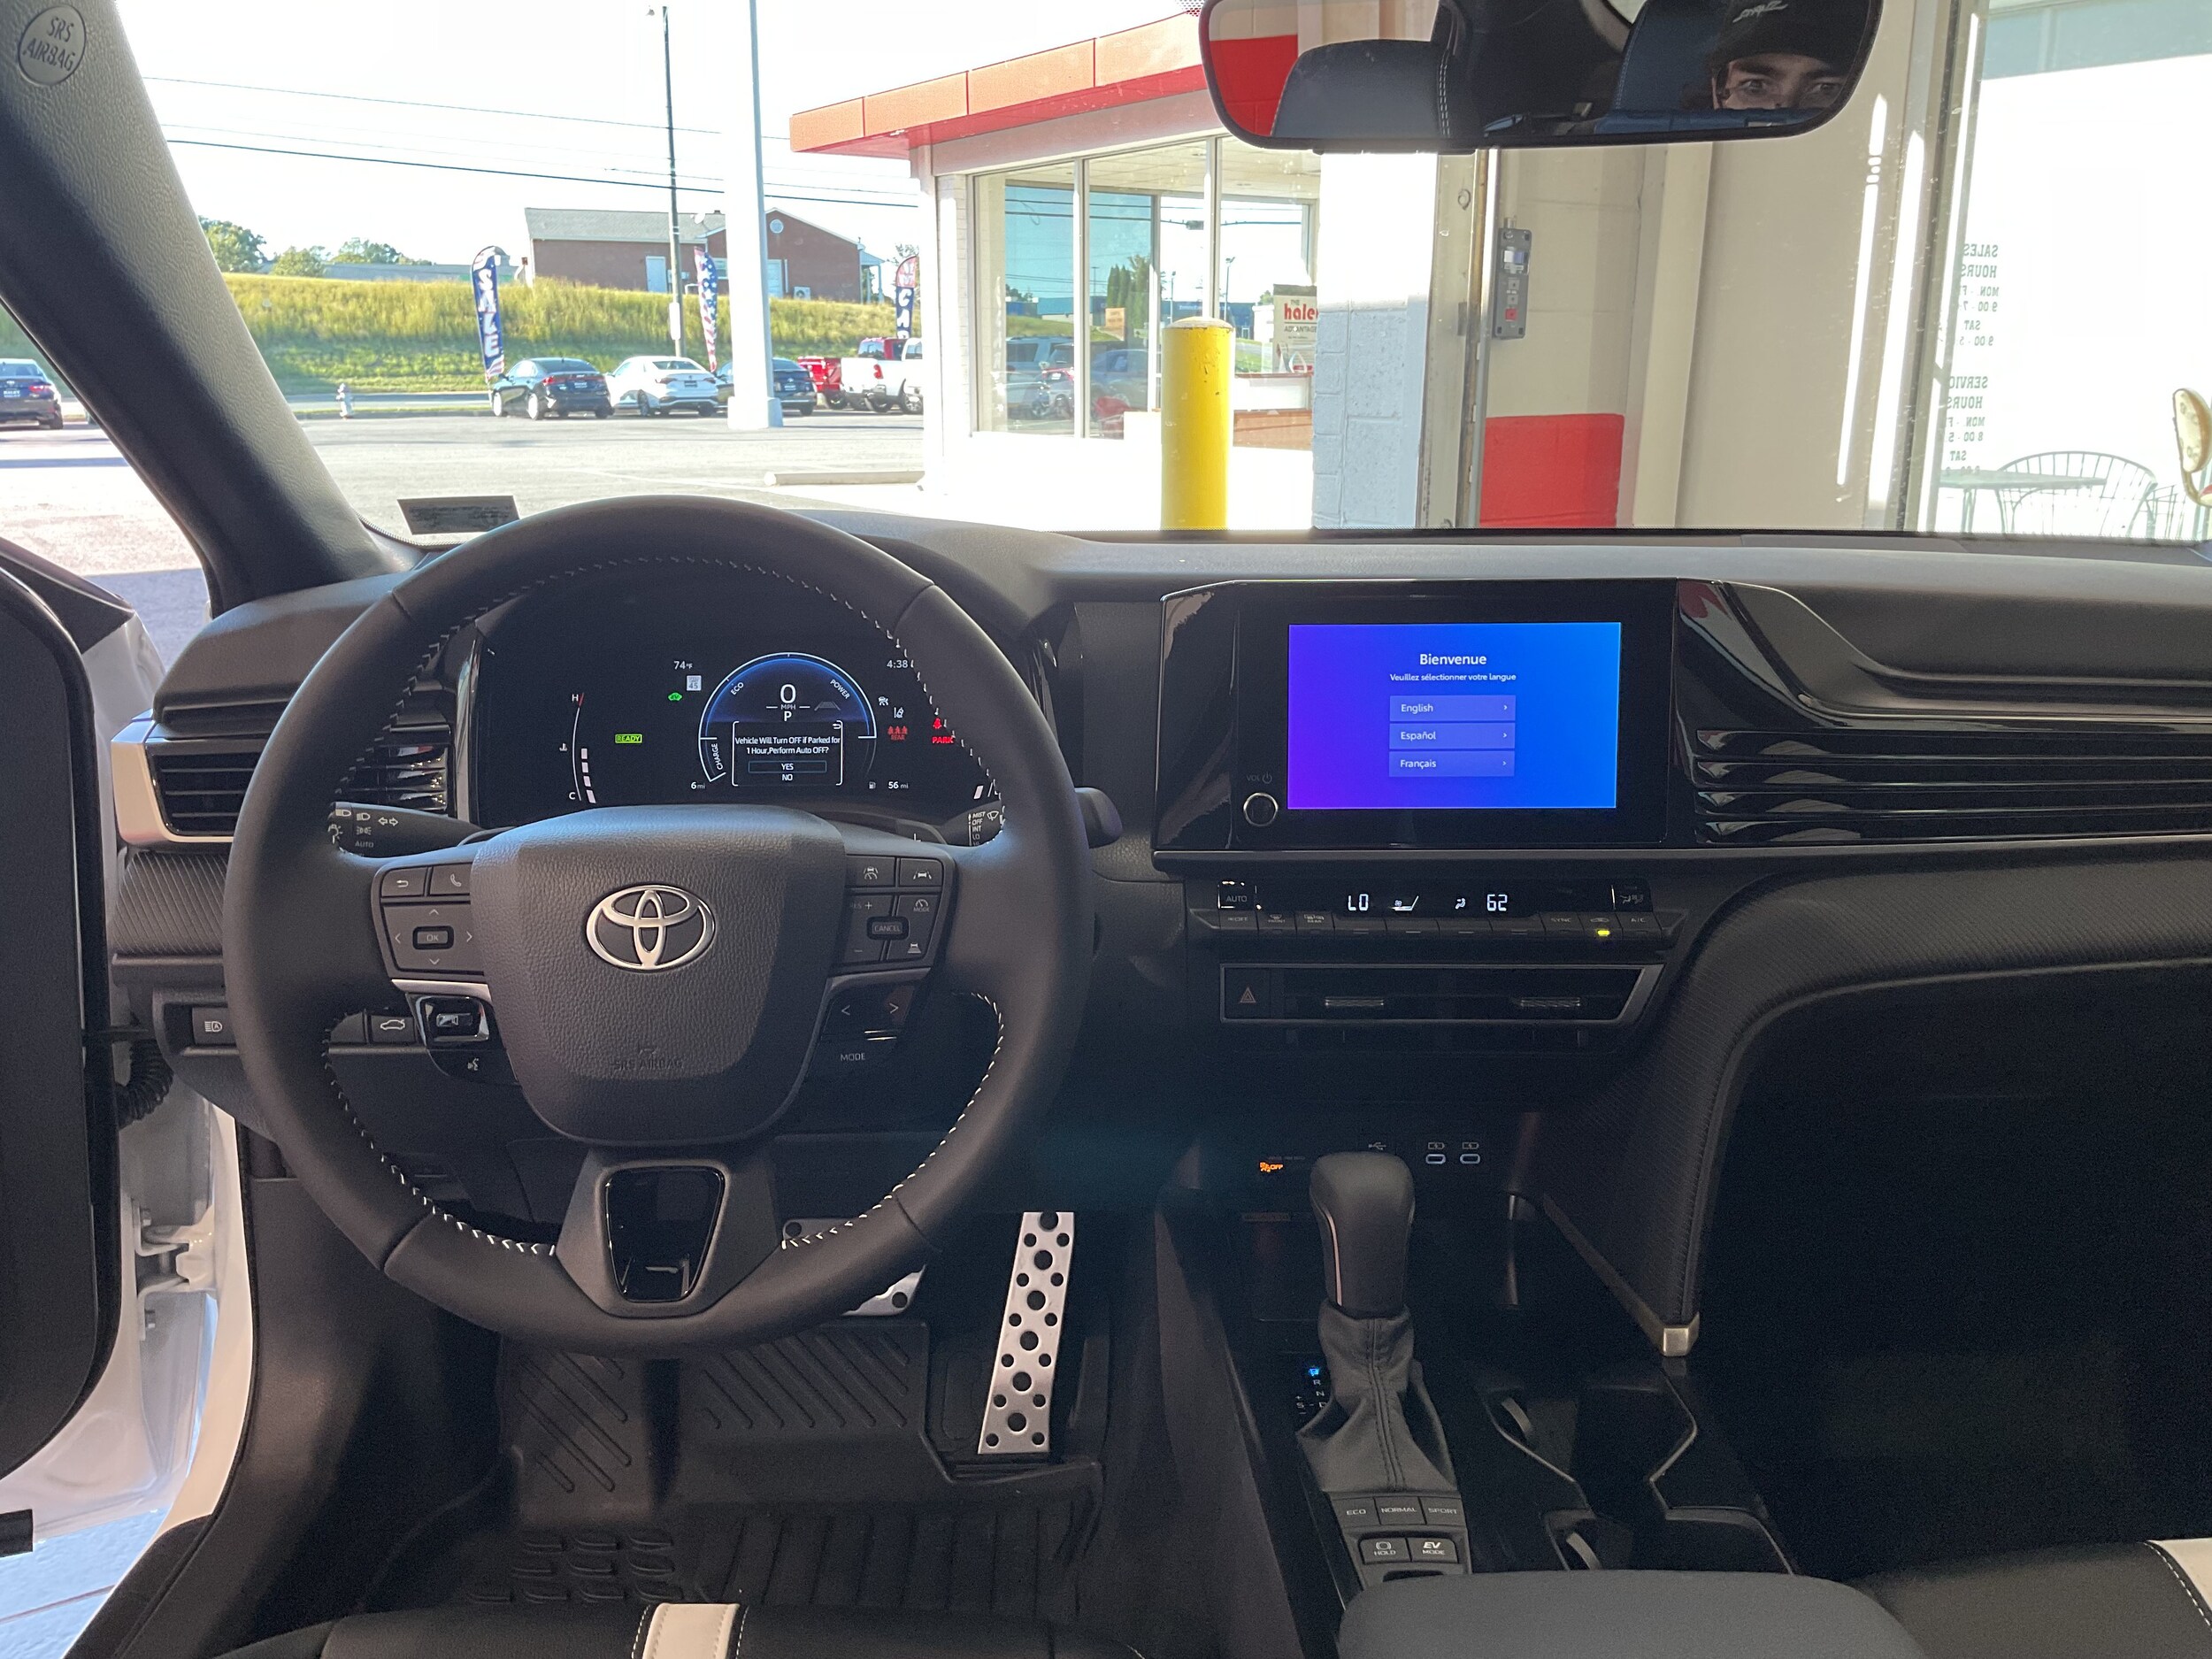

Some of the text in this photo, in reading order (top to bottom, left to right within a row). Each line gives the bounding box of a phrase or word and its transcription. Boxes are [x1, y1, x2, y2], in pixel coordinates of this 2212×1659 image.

[47, 17, 74, 42] SRS
[22, 38, 76, 71] AIRBAG
[478, 268, 499, 357] SALE
[886, 659, 909, 668] 4:38
[1419, 653, 1487, 665] Bienvenue
[1489, 672, 1517, 682] langue
[731, 682, 744, 695] ECO
[780, 684, 796, 704] 0
[830, 679, 851, 700] POWER
[572, 694, 580, 703] H
[1401, 703, 1434, 714] English
[784, 710, 793, 722] P
[1401, 731, 1436, 741] Español
[711, 743, 723, 770] CHARGE
[1400, 759, 1437, 770] Français
[887, 781, 899, 790] 56
[568, 791, 576, 801] C
[1348, 893, 1369, 911] LO
[1486, 894, 1508, 911] 62
[426, 933, 439, 942] OK
